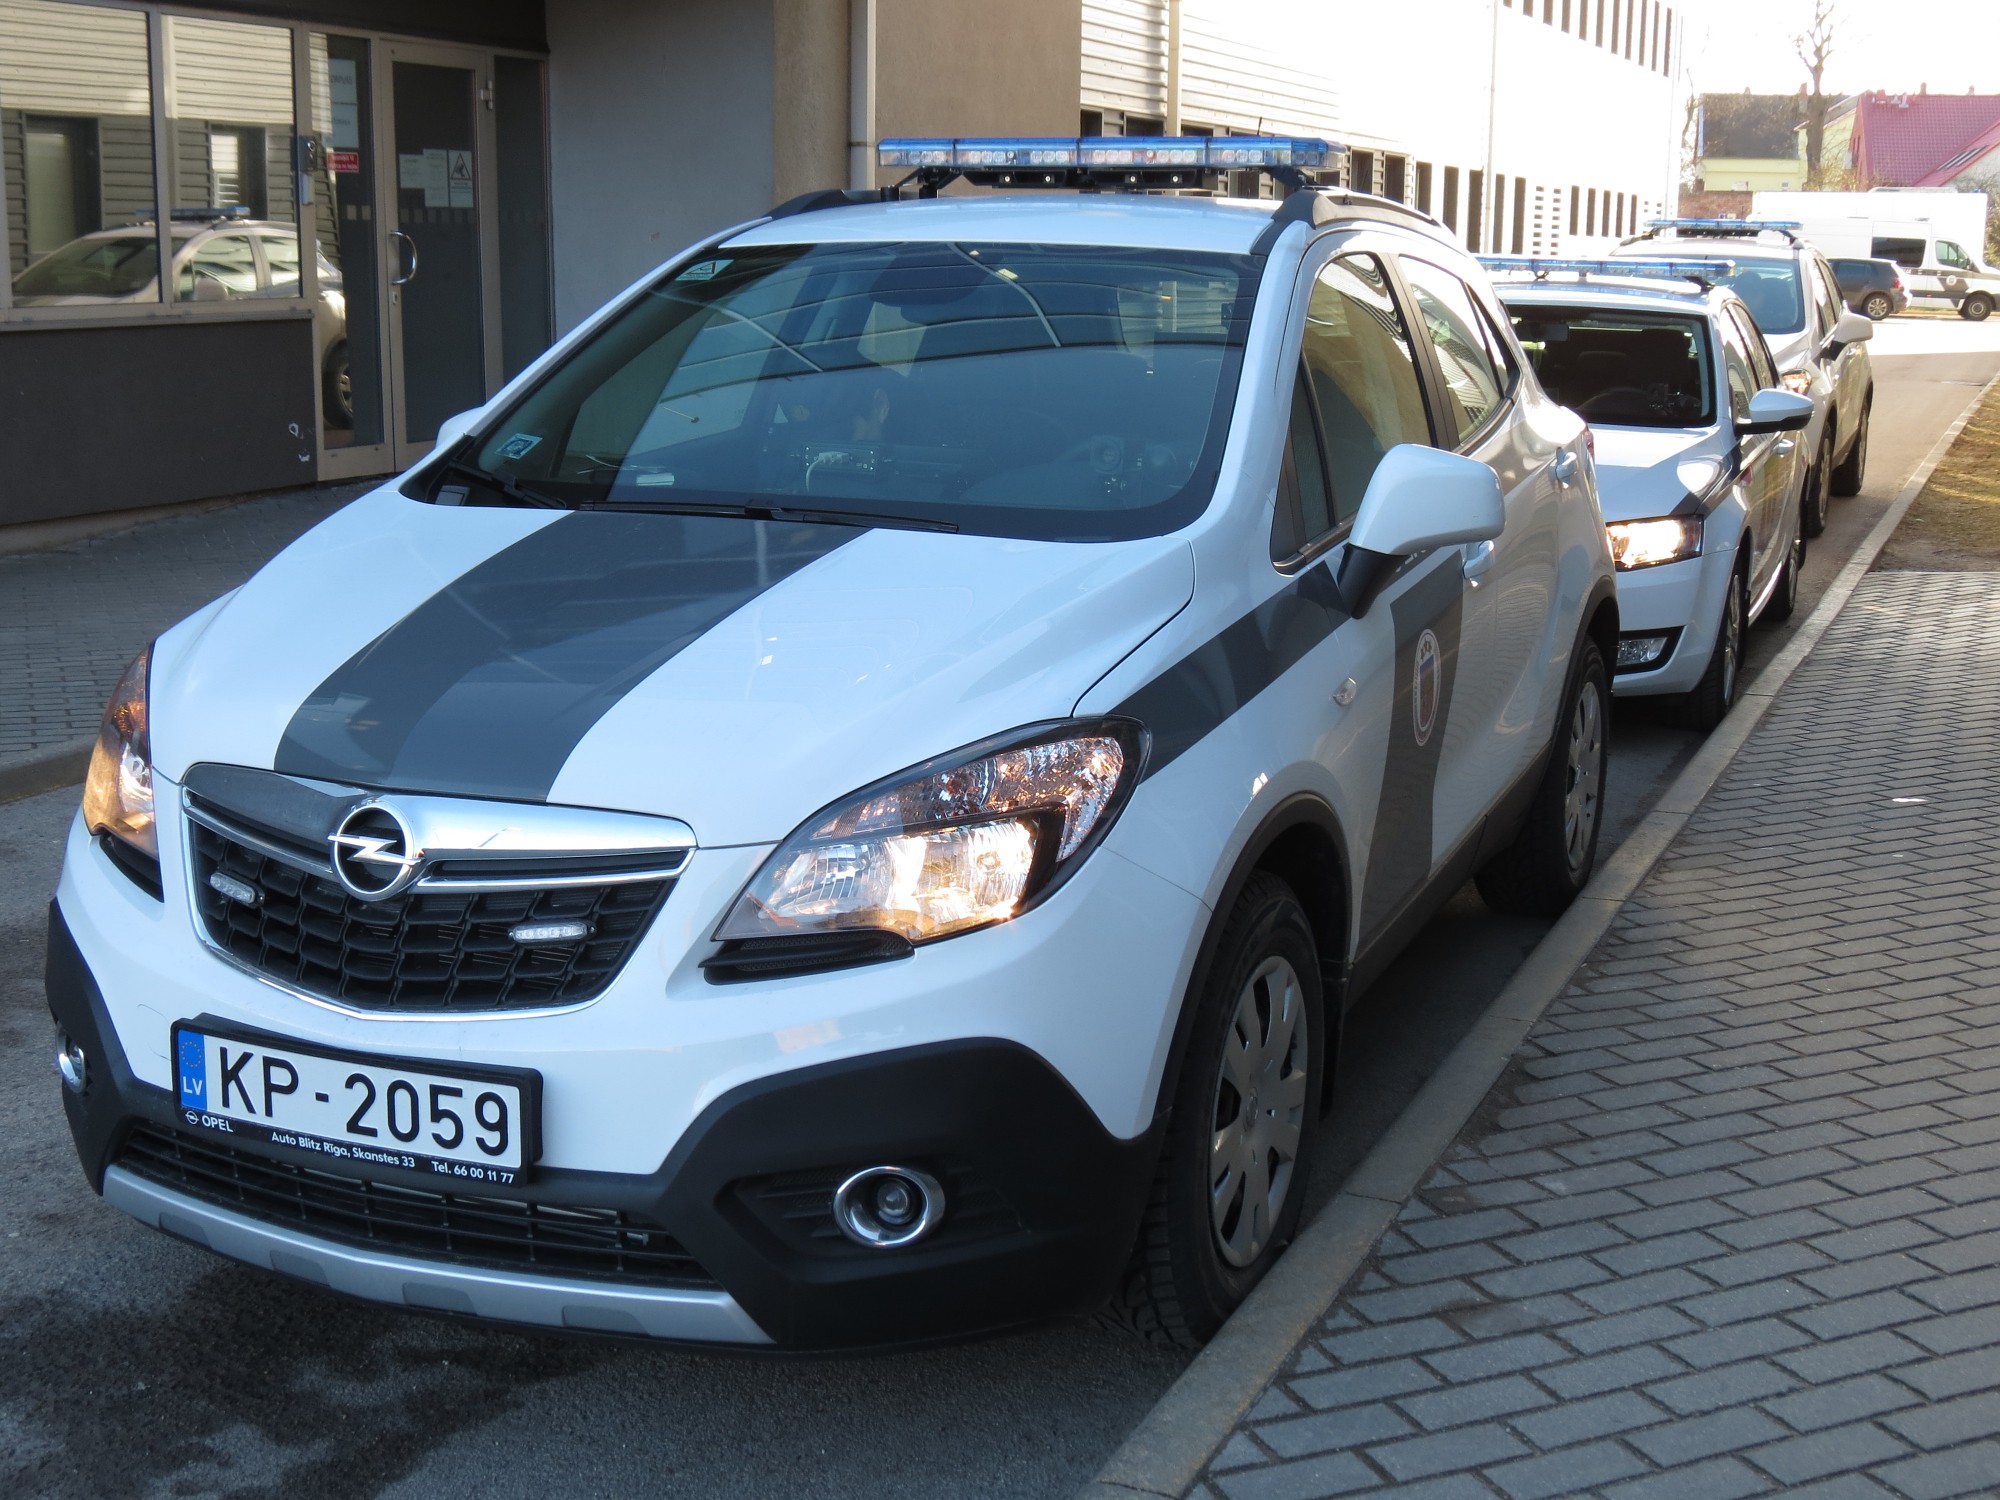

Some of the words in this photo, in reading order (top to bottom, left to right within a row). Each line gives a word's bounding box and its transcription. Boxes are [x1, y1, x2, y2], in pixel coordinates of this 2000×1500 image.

[182, 1076, 203, 1096] LV
[202, 1115, 234, 1133] OPEL
[271, 1131, 296, 1146] Auto
[298, 1137, 321, 1151] Blitz
[352, 1147, 400, 1165] Skanstes
[401, 1156, 415, 1168] 33
[431, 1161, 452, 1174] Tel.
[453, 1164, 468, 1176] 66
[470, 1167, 484, 1179] 00
[487, 1170, 497, 1181] 11
[500, 1172, 515, 1184] 77
